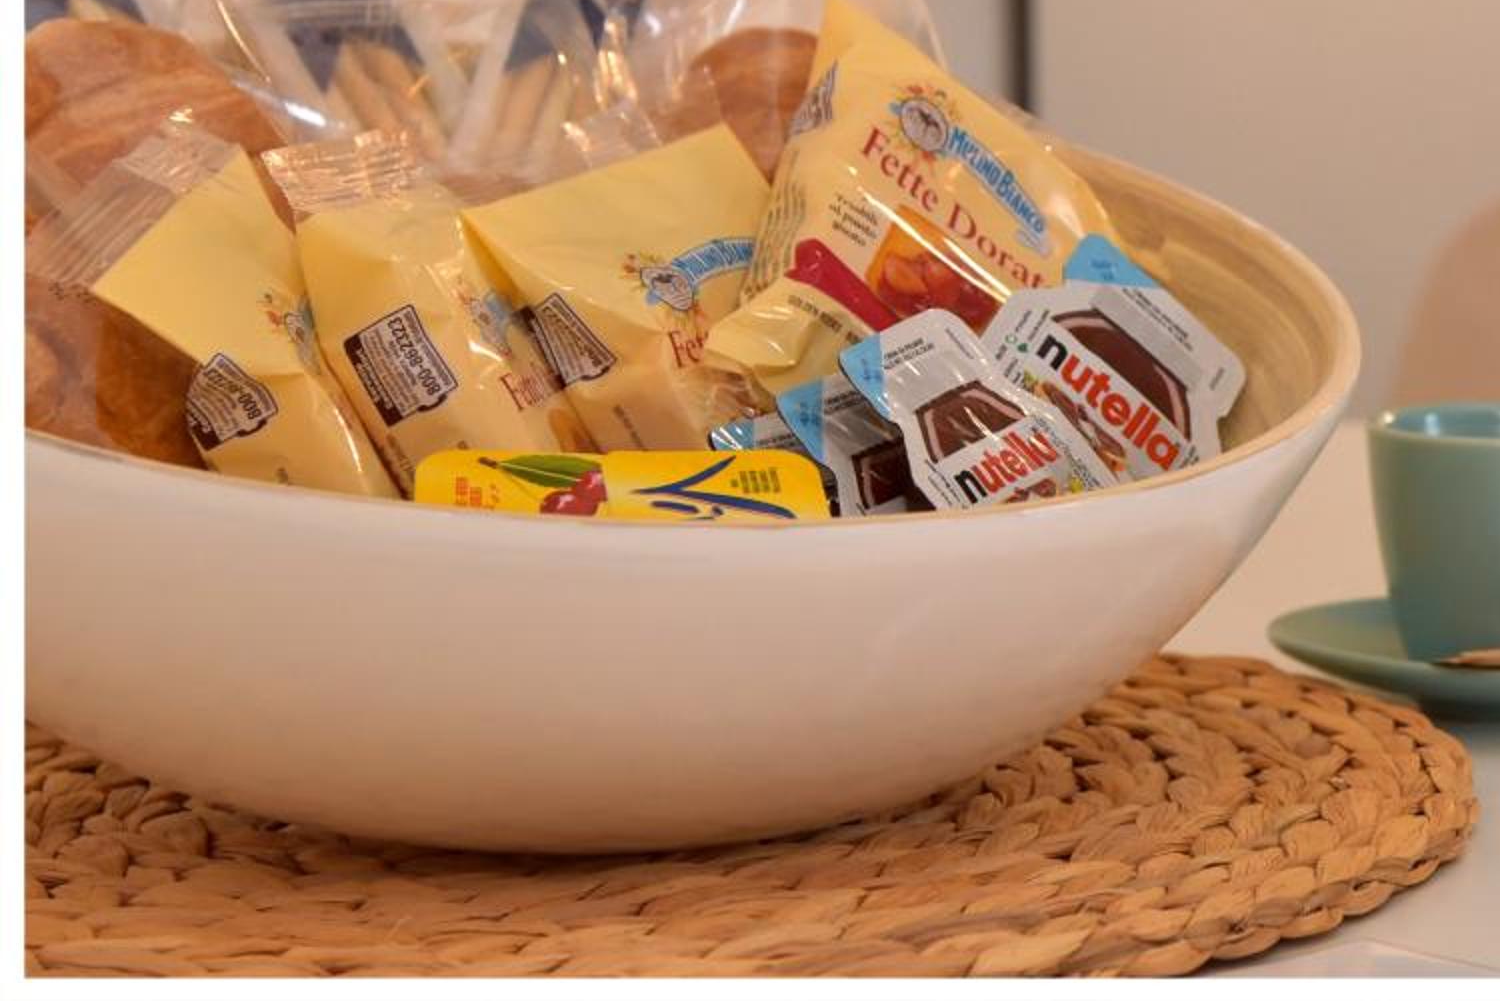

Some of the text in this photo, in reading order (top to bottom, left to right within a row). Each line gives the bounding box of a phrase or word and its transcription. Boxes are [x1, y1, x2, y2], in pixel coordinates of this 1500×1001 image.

[862, 127, 939, 212] Fette
[948, 202, 1044, 288] Dorat
[387, 316, 441, 396] 800-862323
[668, 329, 709, 369] Fet
[1036, 334, 1182, 471] nutella
[953, 430, 1058, 504] nutella
